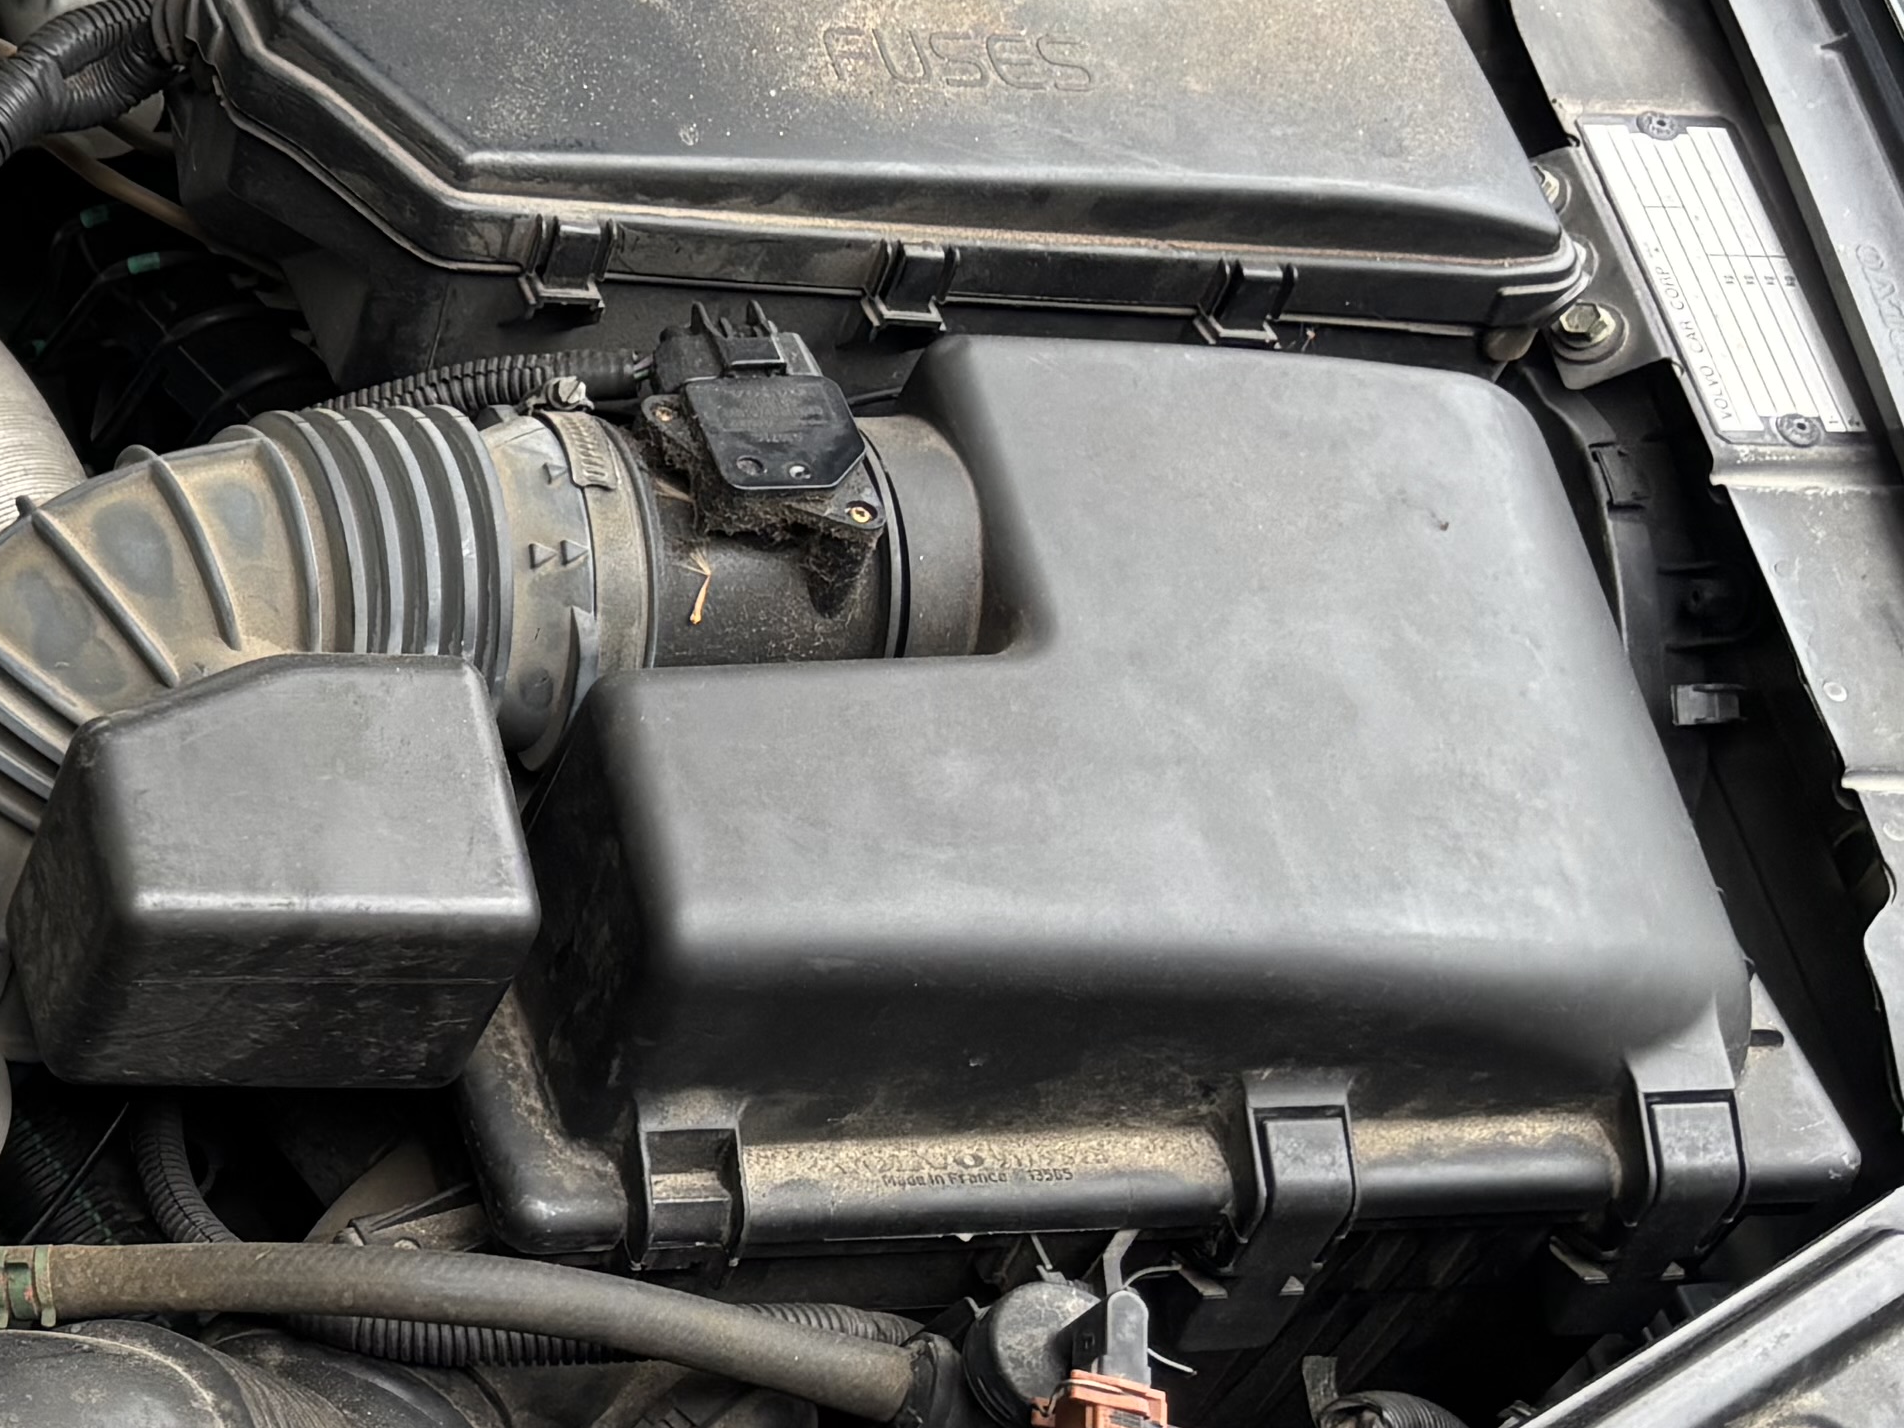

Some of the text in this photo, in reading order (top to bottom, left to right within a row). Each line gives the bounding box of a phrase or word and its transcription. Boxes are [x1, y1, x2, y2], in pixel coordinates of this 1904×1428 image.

[822, 26, 1094, 92] FUSES
[1655, 266, 1732, 420] VOLVO CAR CORP
[949, 1171, 1008, 1185] France
